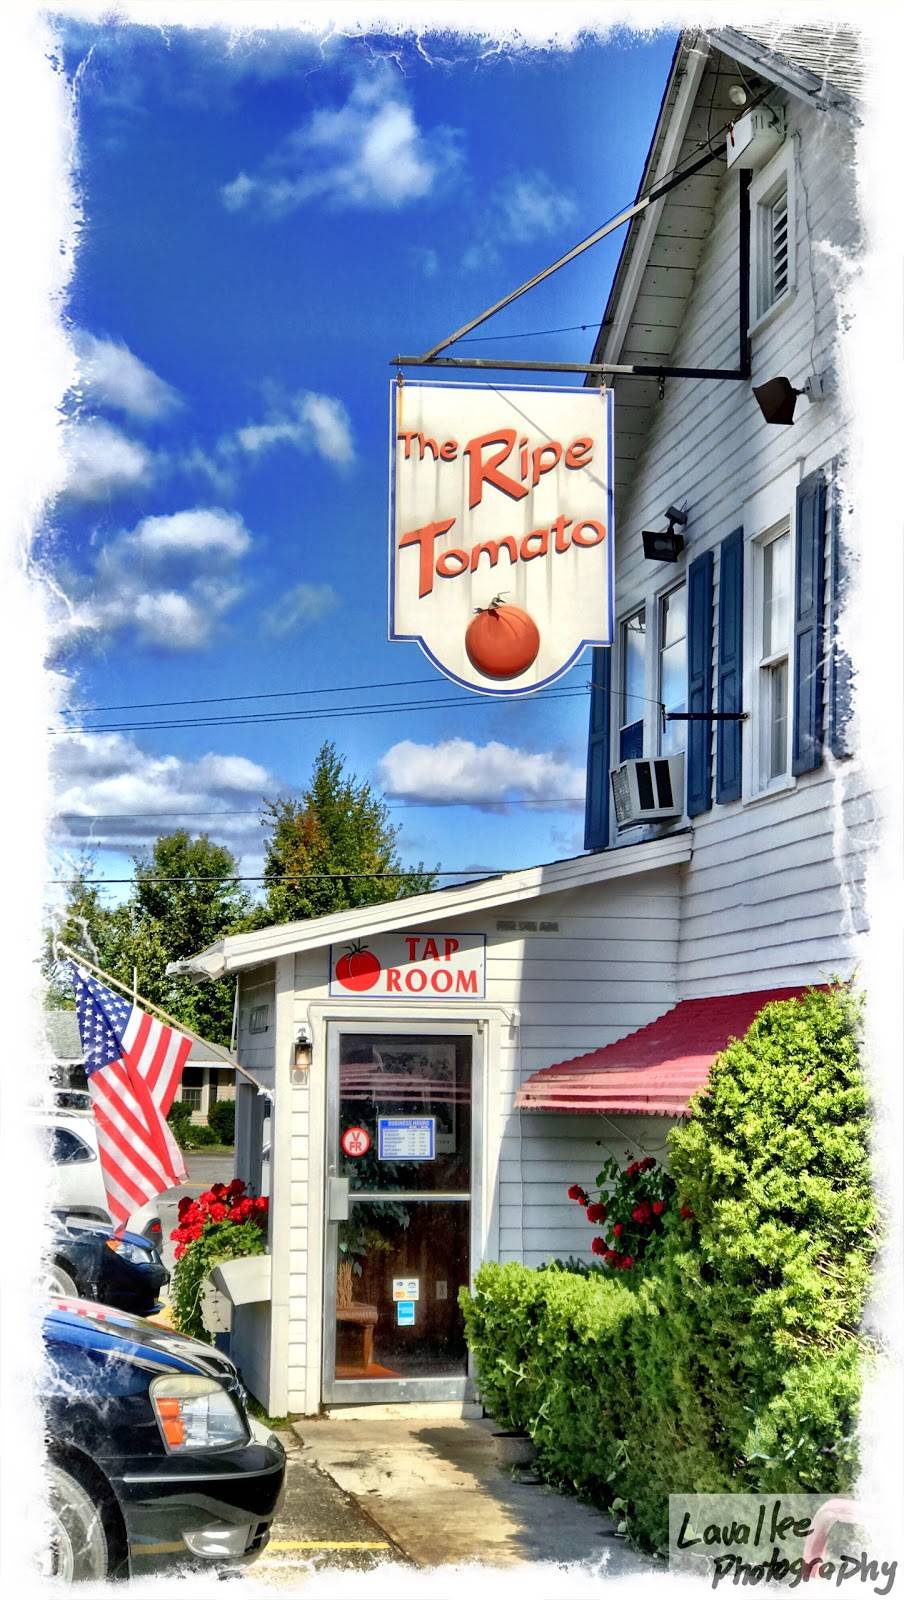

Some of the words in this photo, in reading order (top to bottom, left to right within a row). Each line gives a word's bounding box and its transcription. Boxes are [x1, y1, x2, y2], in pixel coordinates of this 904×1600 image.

[397, 431, 458, 462] The
[464, 428, 594, 510] Ripe
[398, 514, 606, 599] Tomato
[405, 937, 460, 962] TAP
[386, 968, 478, 993] ROOM
